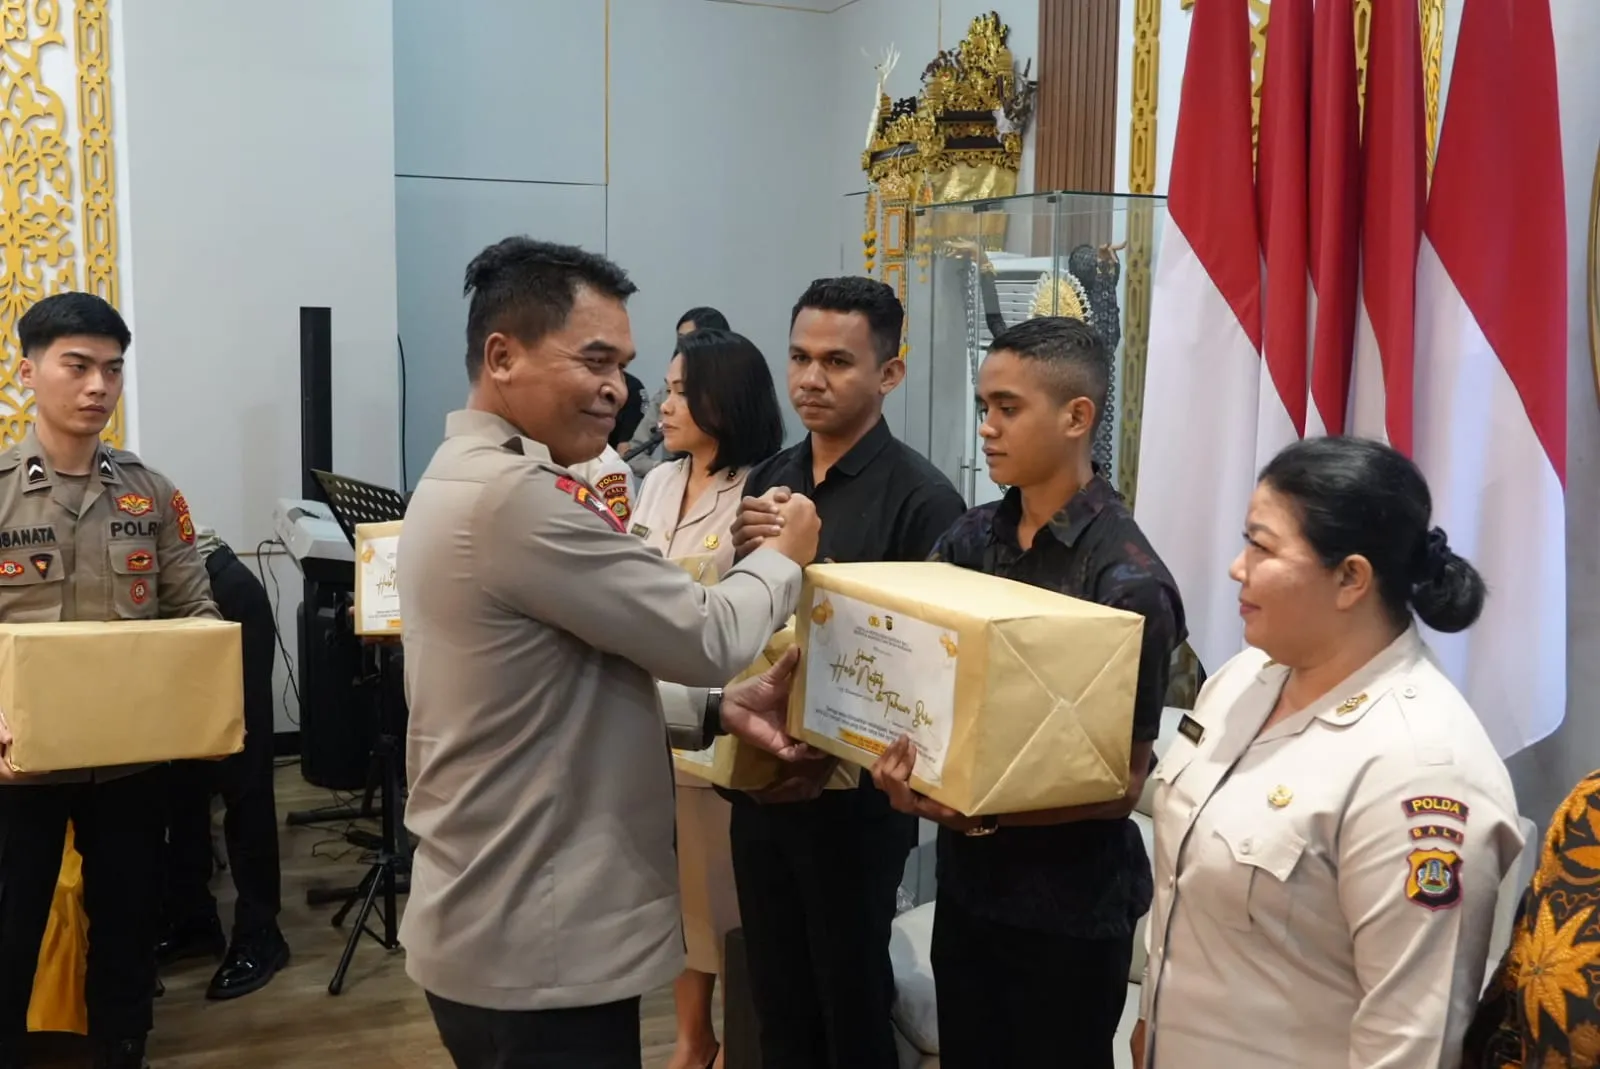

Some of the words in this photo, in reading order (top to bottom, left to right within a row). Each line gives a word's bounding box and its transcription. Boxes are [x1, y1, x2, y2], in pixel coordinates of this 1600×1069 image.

[598, 474, 624, 488] POLDA
[1411, 798, 1460, 814] POLDA
[1412, 826, 1461, 842] BALI
